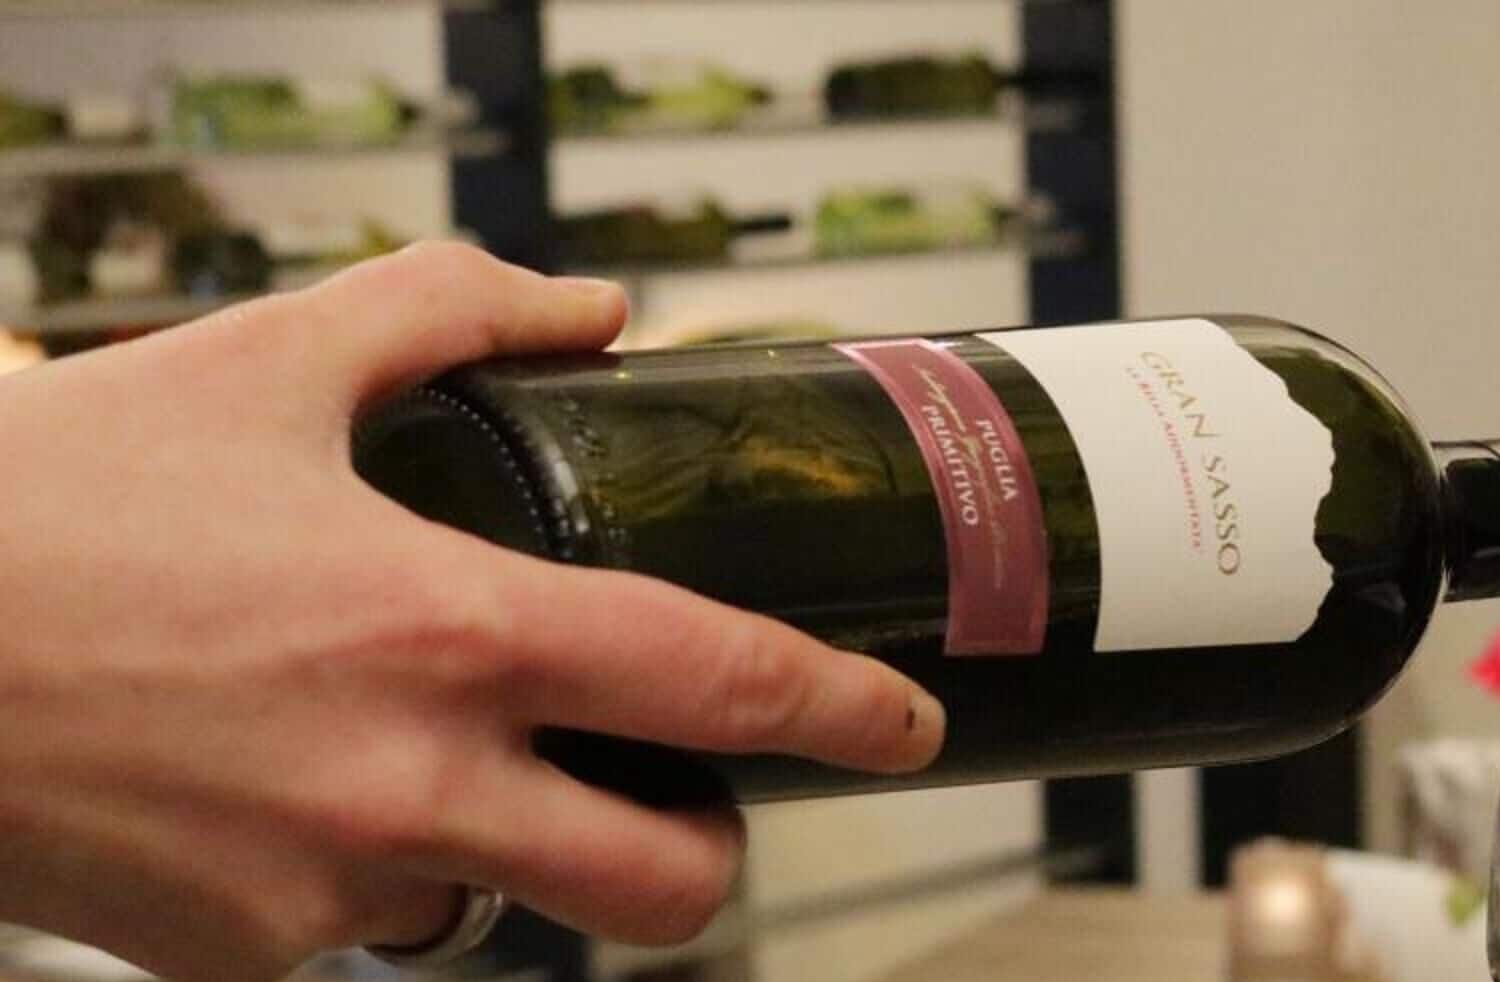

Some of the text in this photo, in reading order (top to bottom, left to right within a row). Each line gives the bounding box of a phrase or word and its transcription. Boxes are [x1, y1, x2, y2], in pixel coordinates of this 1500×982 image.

[921, 405, 979, 526] PRIMITIVO
[975, 417, 1019, 501] PUGLIA
[1141, 351, 1221, 438] GRAN
[1203, 453, 1240, 576] SASSO
